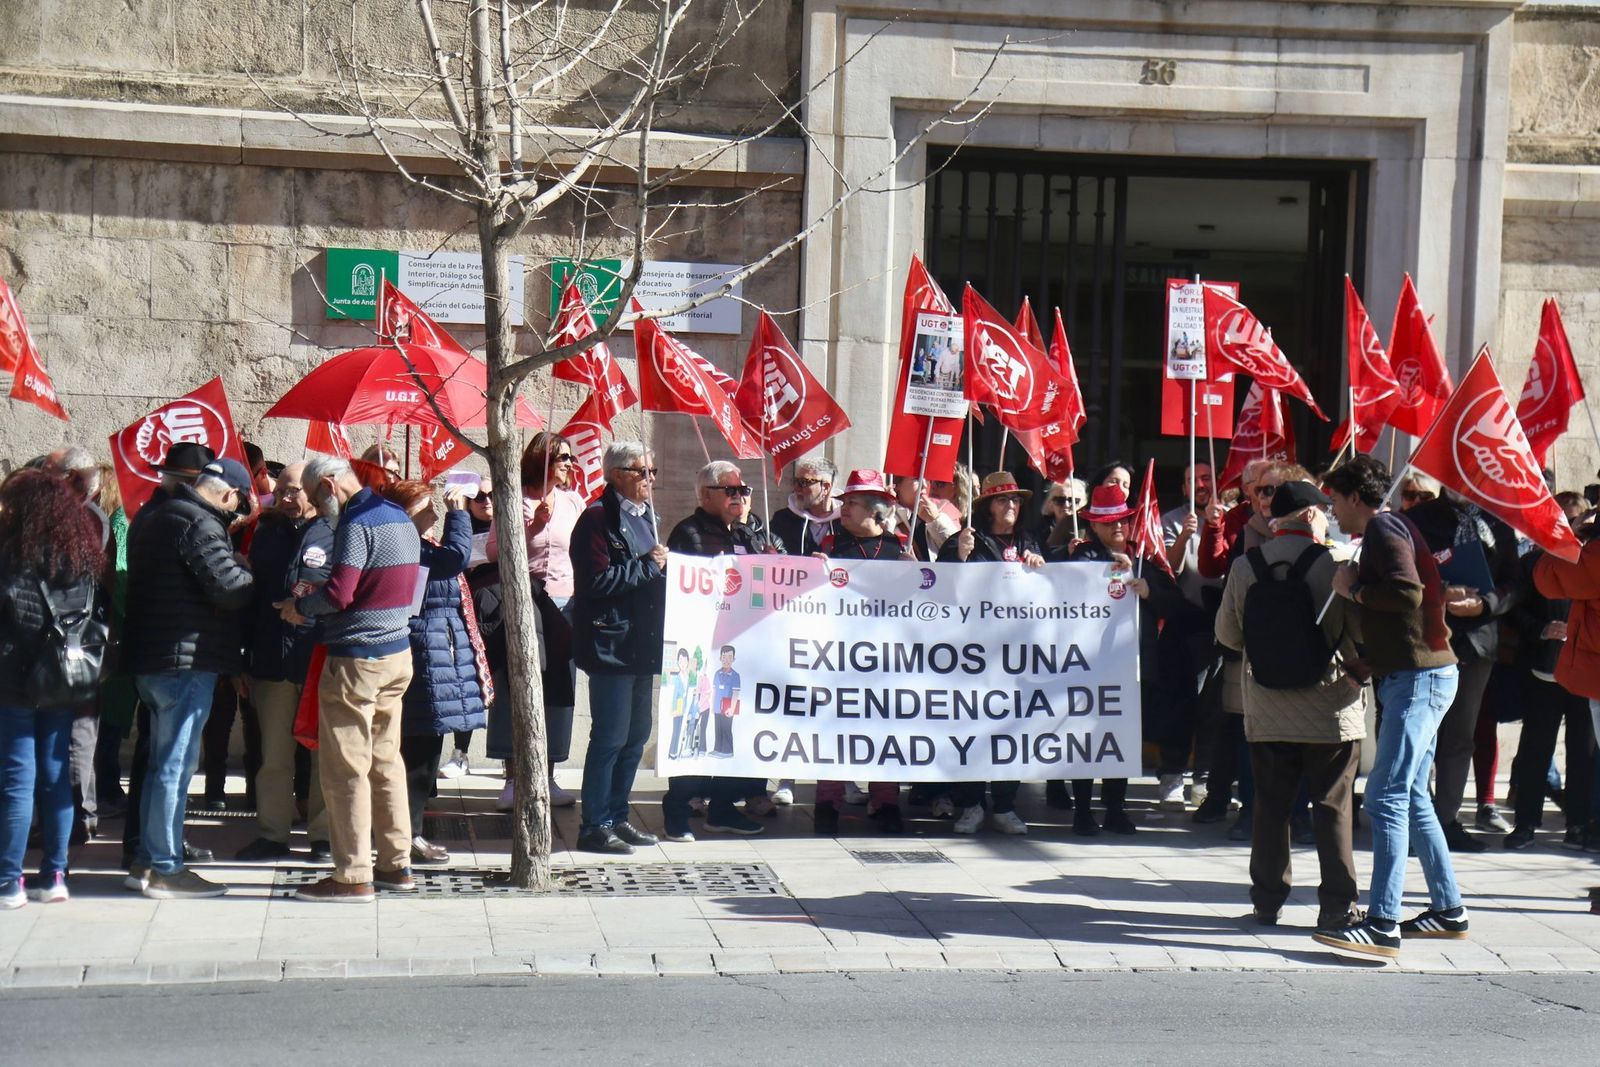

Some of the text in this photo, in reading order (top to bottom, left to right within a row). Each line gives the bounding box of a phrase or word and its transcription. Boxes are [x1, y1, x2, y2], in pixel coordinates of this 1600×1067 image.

[1139, 60, 1176, 85] 56
[408, 261, 446, 269] Consejería
[408, 271, 438, 279] Interior,
[440, 272, 467, 280] Diálogo
[642, 270, 674, 279] onsejería
[686, 271, 722, 280] Desarrollo
[408, 280, 459, 290] Simplificación
[416, 300, 447, 310] legación
[920, 319, 939, 329] UGT
[1173, 363, 1190, 371] UGT
[385, 391, 419, 403] U.G.T.
[772, 567, 808, 587] UJP
[772, 592, 1112, 624] Unión Jubilad@s y Pensionistas
[788, 637, 1092, 675] EXIGIMOS UNA
[754, 682, 1123, 721] DEPENDENCIA DE
[753, 730, 1125, 766] CALIDAD Y DIGNA
